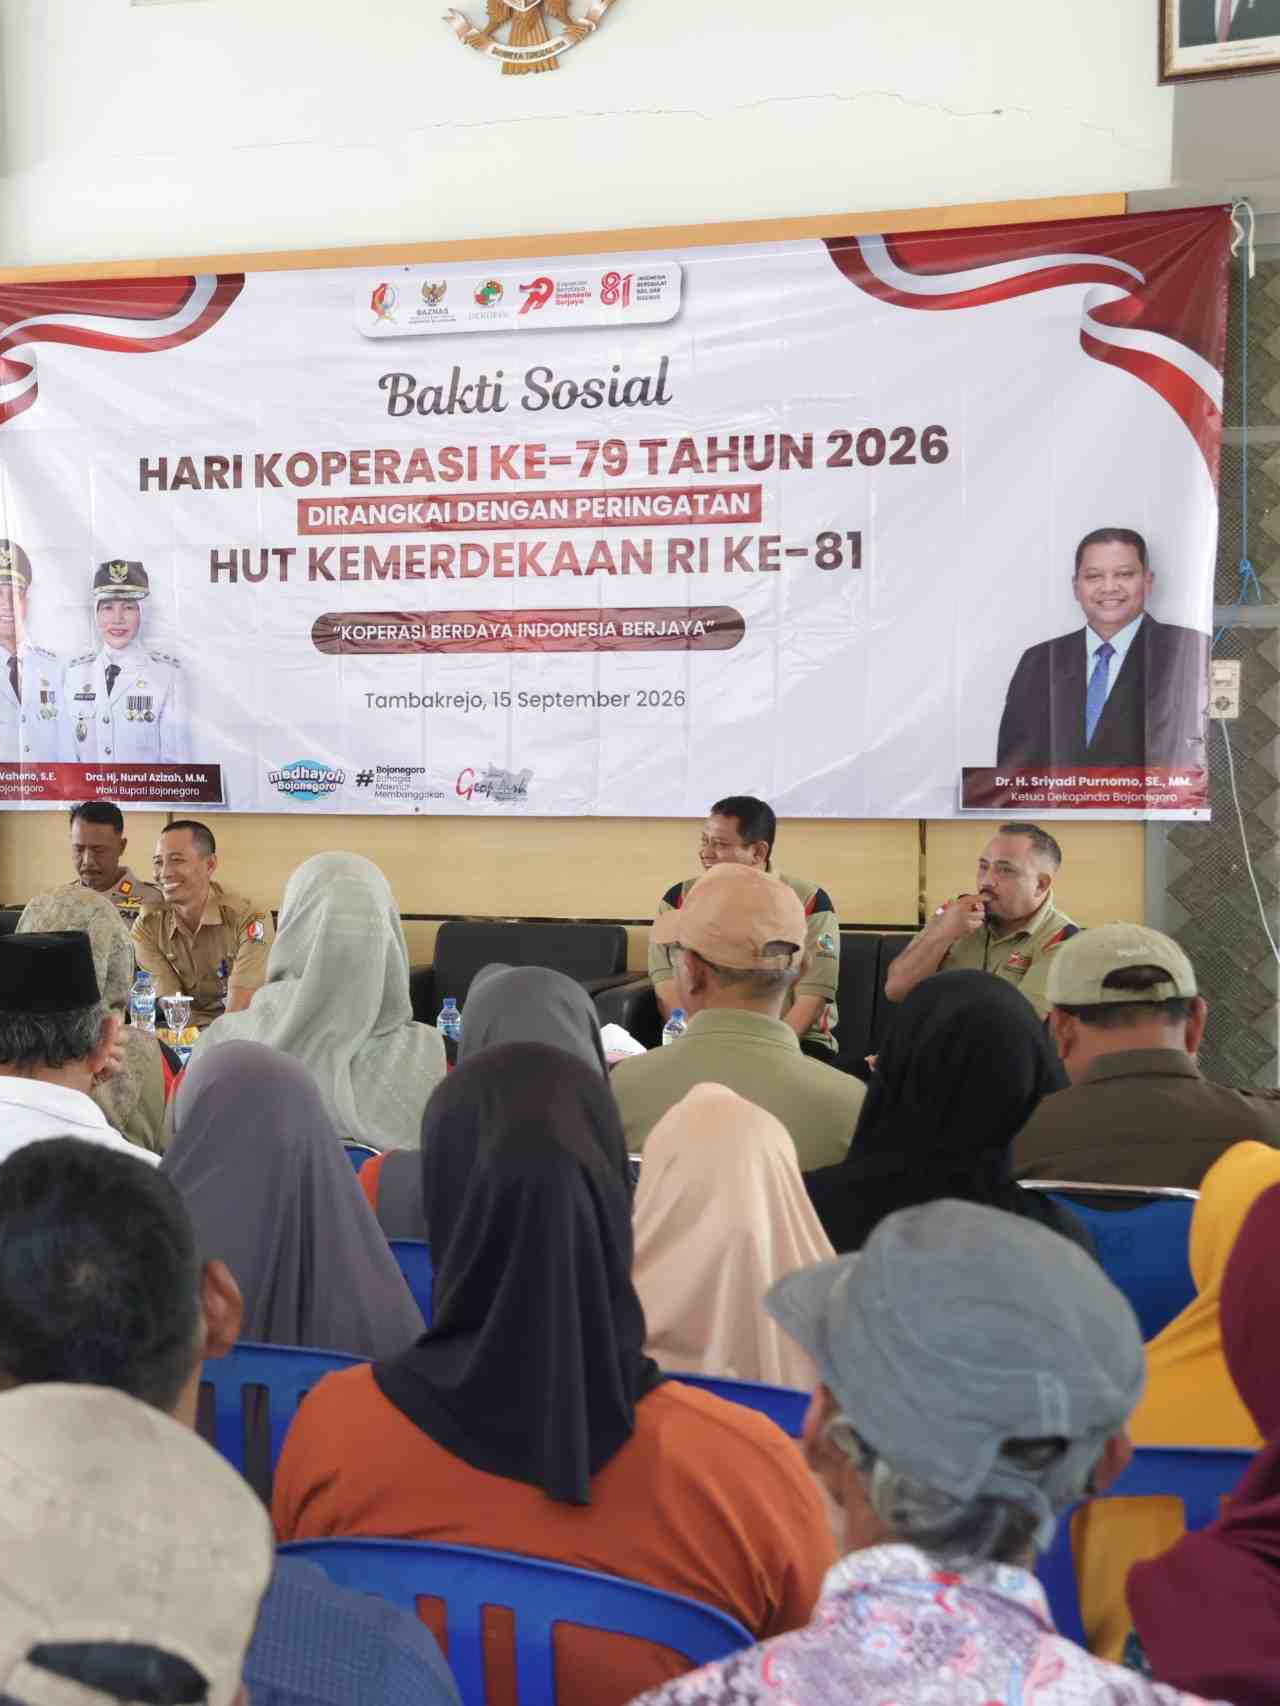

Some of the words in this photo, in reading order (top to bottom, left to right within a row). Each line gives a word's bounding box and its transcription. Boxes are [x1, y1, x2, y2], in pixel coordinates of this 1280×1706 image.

[378, 365, 509, 417] Bakti
[521, 355, 673, 412] Sosial
[139, 454, 243, 492] HARI
[255, 445, 478, 488] KOPERASI
[490, 437, 629, 482] KE-79
[639, 432, 814, 476] TAHUN
[826, 424, 949, 468] 2026
[307, 501, 451, 527] DIRANGKAI
[457, 497, 568, 523] DENGAN
[575, 492, 750, 519] PERINGATAN
[209, 547, 297, 584] HUT
[308, 537, 653, 582] KEMERDEKAAN
[666, 536, 710, 575] RI
[723, 530, 863, 574] KE-81
[431, 623, 513, 640] BERDAYA
[518, 621, 617, 638] INDONESIA
[364, 691, 488, 713] Tambakrejo,
[492, 691, 512, 708] 15
[517, 690, 631, 713] September
[636, 690, 686, 707] 2026
[40, 772, 57, 781] S.E.
[269, 766, 346, 785] medhayoh
[376, 765, 426, 776] Bojonegoro
[85, 773, 105, 782] Dra.
[107, 773, 119, 785] Hj.
[120, 773, 147, 783] Nurul
[148, 773, 184, 784] Azizah,
[185, 774, 208, 783] M.M.
[995, 776, 1013, 786] Dr.
[1016, 776, 1028, 786] H.
[1031, 776, 1076, 789] Sriyadi
[1078, 776, 1143, 788] Purnomo,
[1145, 776, 1167, 788] SE.,
[1169, 776, 1192, 786] MM.
[95, 784, 118, 795] Wakil
[119, 785, 148, 797] Bupati
[150, 786, 200, 798] Bojonegoro
[277, 781, 337, 793] Bojonegoro
[374, 791, 445, 801] Membanggakan
[1010, 792, 1044, 802] Ketua
[1047, 792, 1110, 804] Dekopinda
[1113, 792, 1177, 804] Bojonegoro
